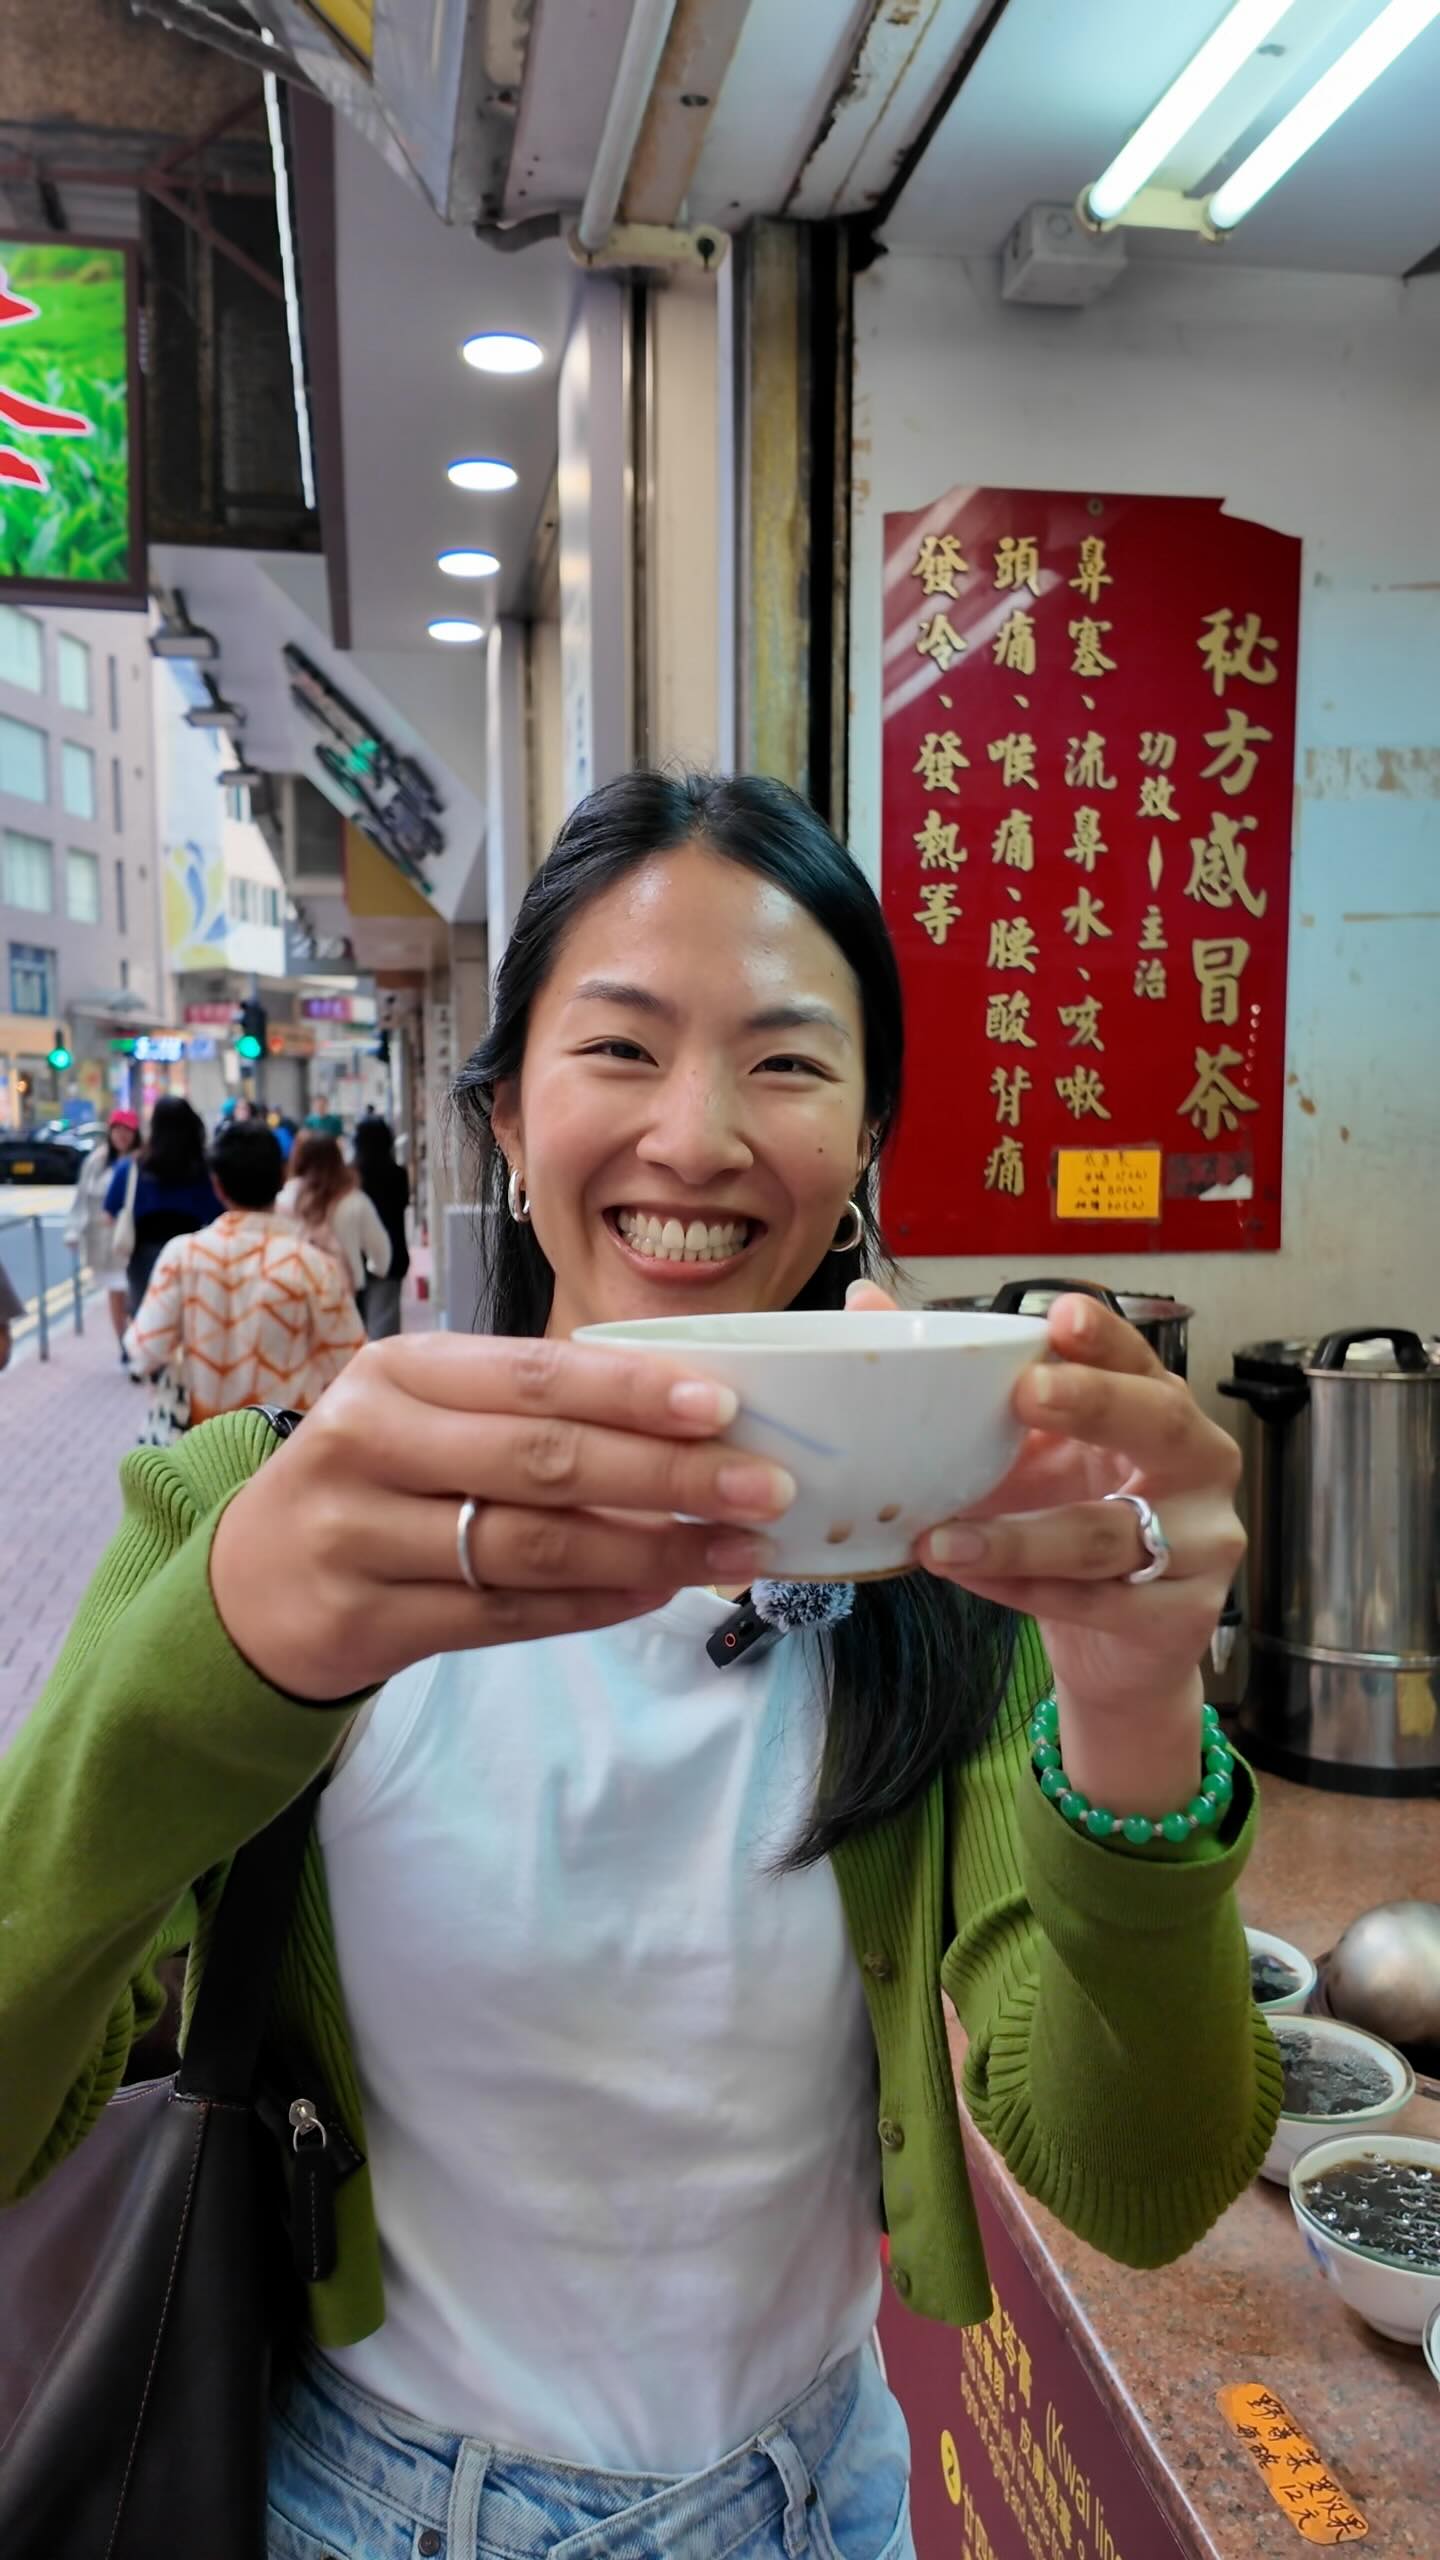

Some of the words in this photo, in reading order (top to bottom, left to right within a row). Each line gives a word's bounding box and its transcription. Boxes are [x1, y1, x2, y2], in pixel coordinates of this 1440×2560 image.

[1176, 607, 1279, 1141] 秘方感冒茶
[1095, 2496, 1123, 2560] lin
